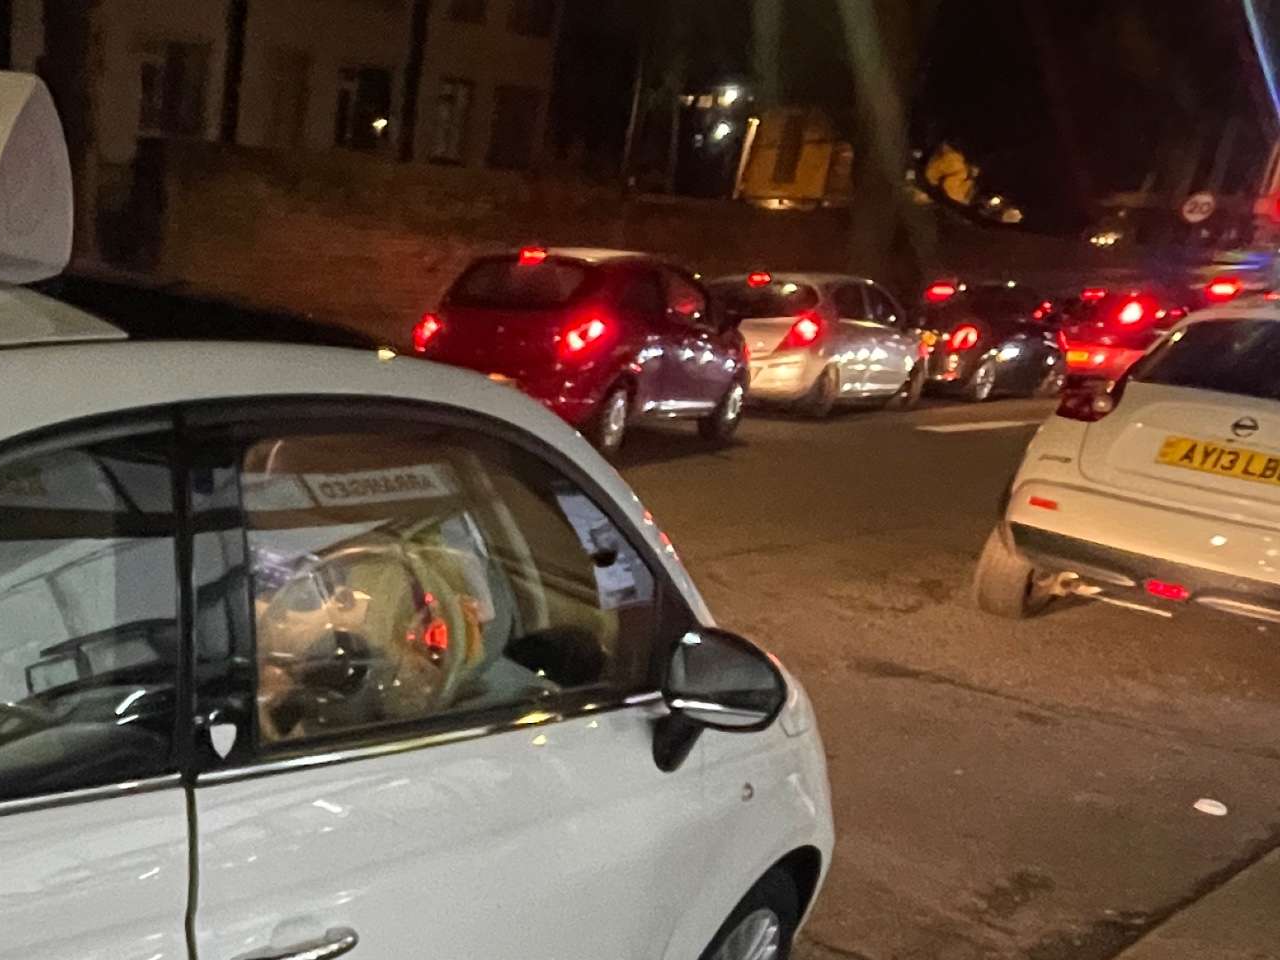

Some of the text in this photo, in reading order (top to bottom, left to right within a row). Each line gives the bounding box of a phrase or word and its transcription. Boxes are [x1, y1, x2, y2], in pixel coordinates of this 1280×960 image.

[1186, 201, 1211, 214] 20
[1179, 443, 1280, 481] AY13 LB
